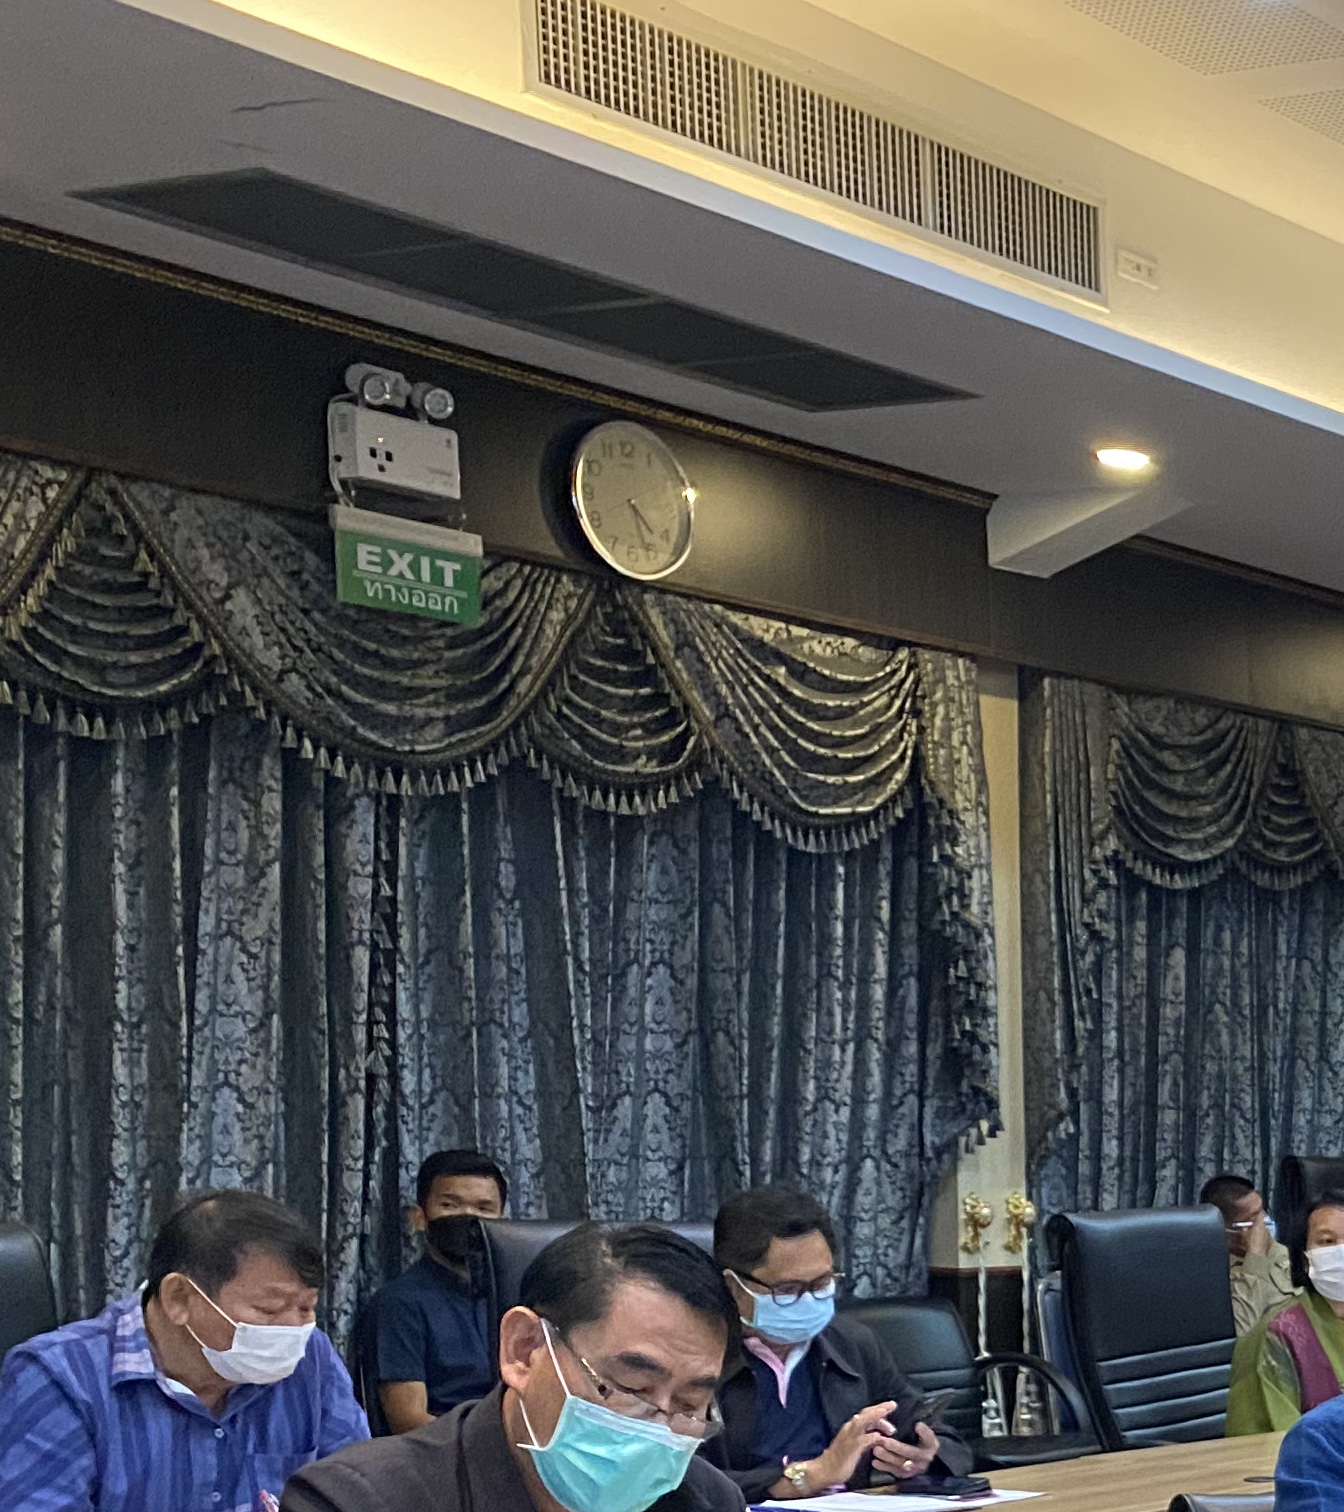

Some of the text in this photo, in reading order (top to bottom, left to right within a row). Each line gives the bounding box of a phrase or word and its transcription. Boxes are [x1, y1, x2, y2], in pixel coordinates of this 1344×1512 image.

[356, 543, 461, 588] EXIT
[364, 579, 459, 615] ทางออก
